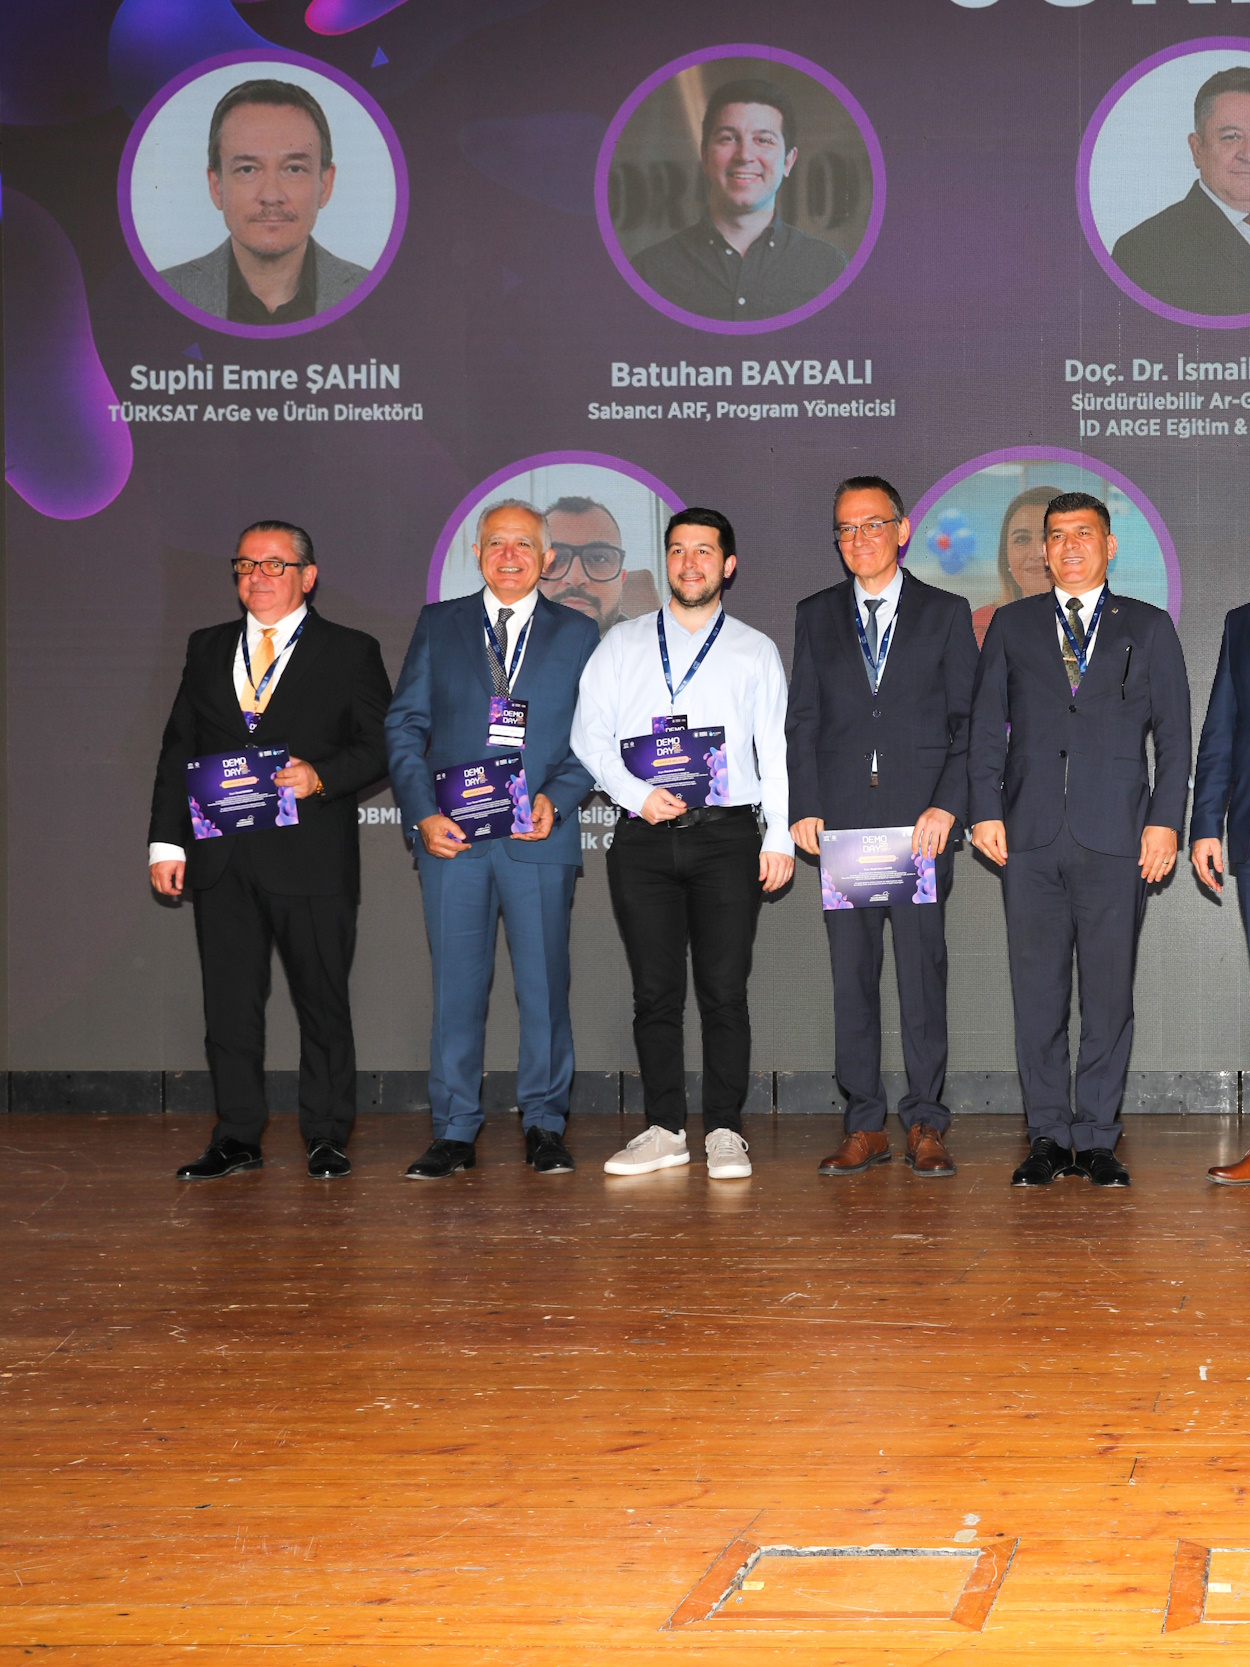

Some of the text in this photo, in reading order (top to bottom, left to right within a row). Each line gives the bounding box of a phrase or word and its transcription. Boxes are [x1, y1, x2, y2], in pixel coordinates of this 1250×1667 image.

[130, 358, 400, 395] Suphi Emre ŞAHİN
[611, 359, 872, 388] Batuhan BAYBALI
[1065, 359, 1124, 387] Doç.
[1132, 358, 1169, 381] Dr.
[1071, 391, 1205, 411] Sürdürülebilir
[107, 400, 423, 423] TÜRKSAT ArGe ve Ürün Direktörü
[588, 398, 896, 422] Sabancı ARF, Program Yöneticisi
[1079, 418, 1100, 437] ID
[1105, 418, 1161, 437] ARGE
[1166, 418, 1229, 439] Eğitim
[1233, 417, 1248, 435] &
[503, 710, 524, 718] DEMO
[656, 737, 680, 747] DEMO
[656, 747, 675, 756] DAY
[222, 757, 247, 768] DEMO
[223, 768, 242, 778] DAY
[464, 766, 484, 778] DEMO
[464, 776, 481, 787] DAY
[862, 835, 887, 844] DEMO
[862, 844, 881, 853] DAY
